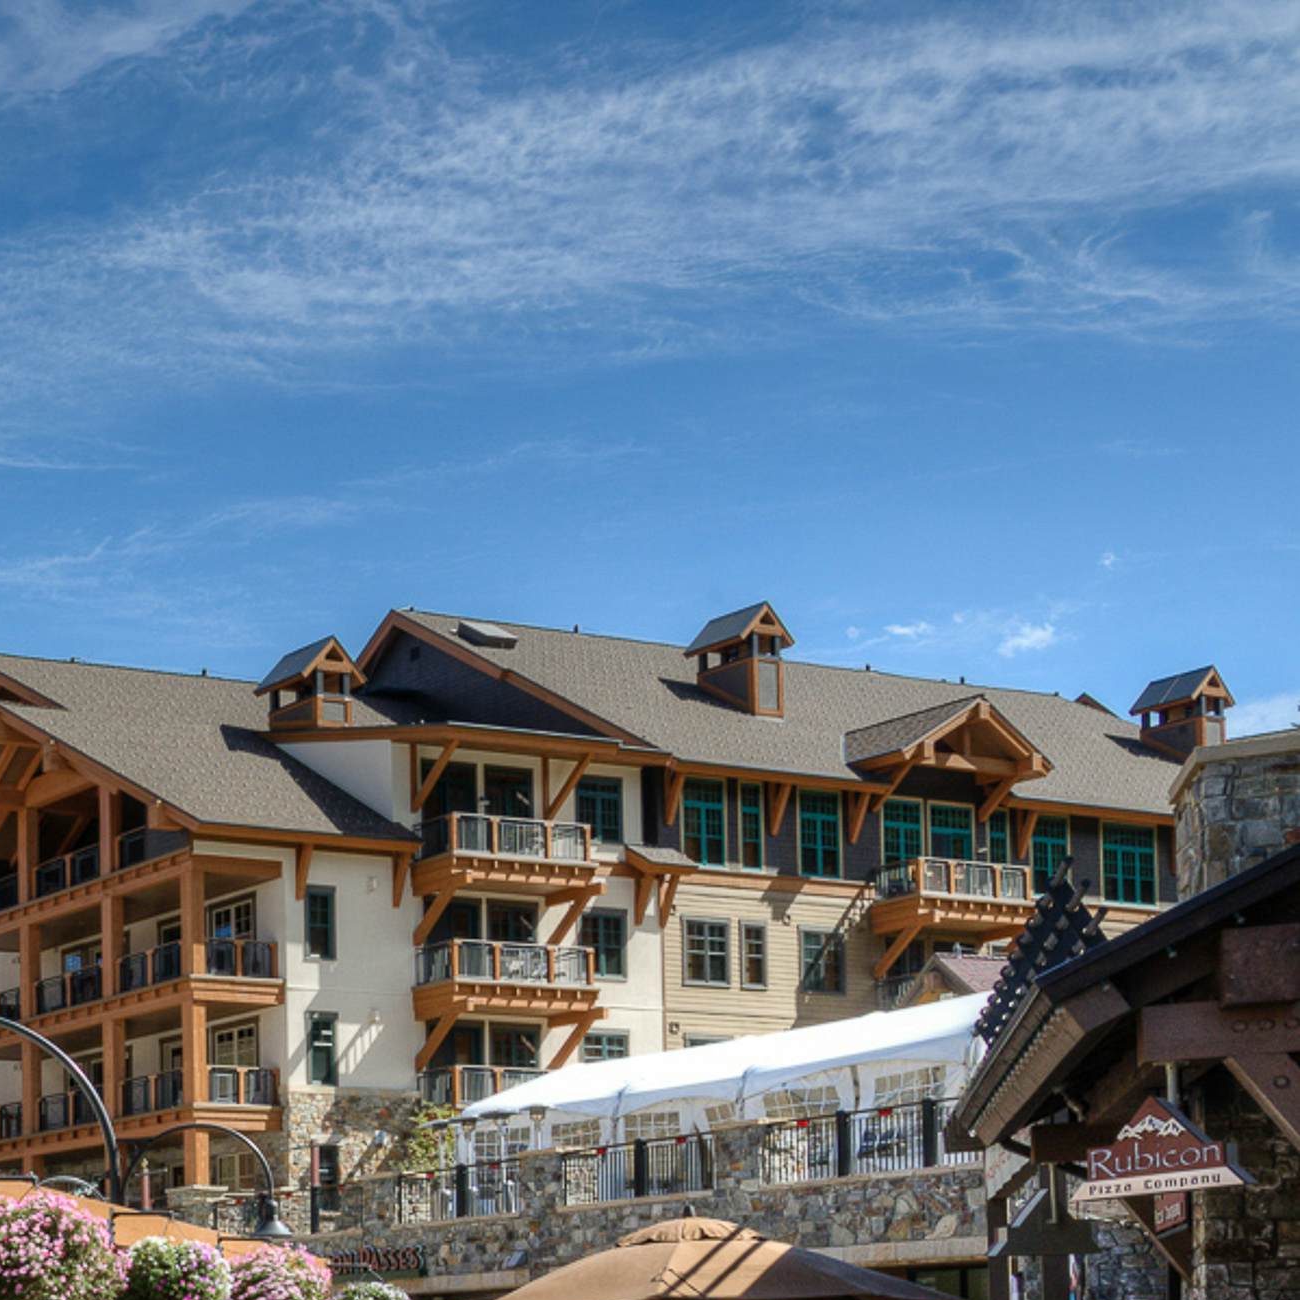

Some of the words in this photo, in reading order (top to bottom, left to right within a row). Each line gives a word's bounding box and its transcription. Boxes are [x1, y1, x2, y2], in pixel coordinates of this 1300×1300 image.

[1089, 1141, 1223, 1180] Rubicon
[1088, 1183, 1132, 1196] Pizza
[1143, 1172, 1222, 1191] Company
